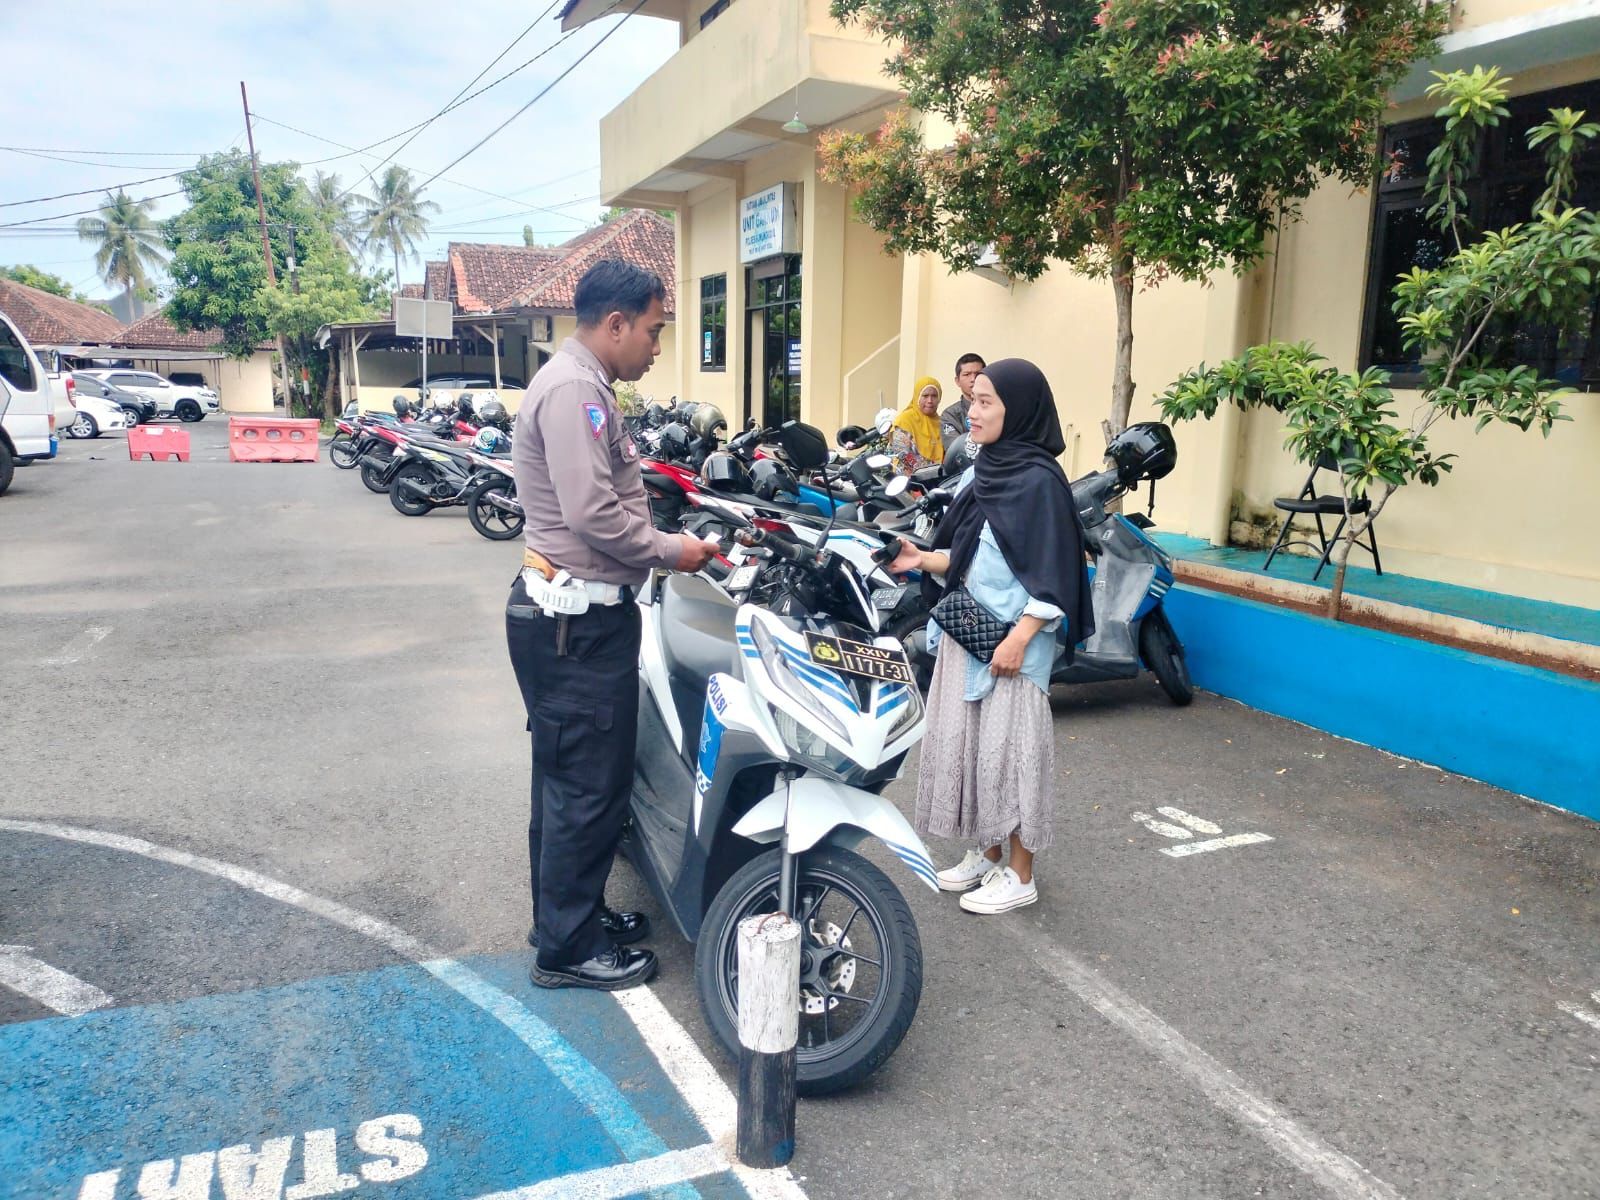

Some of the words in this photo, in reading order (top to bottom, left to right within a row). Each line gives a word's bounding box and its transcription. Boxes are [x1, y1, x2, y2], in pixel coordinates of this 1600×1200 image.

[854, 645, 891, 659] XXIV
[846, 654, 909, 681] 1177-31
[708, 674, 729, 716] POLISI
